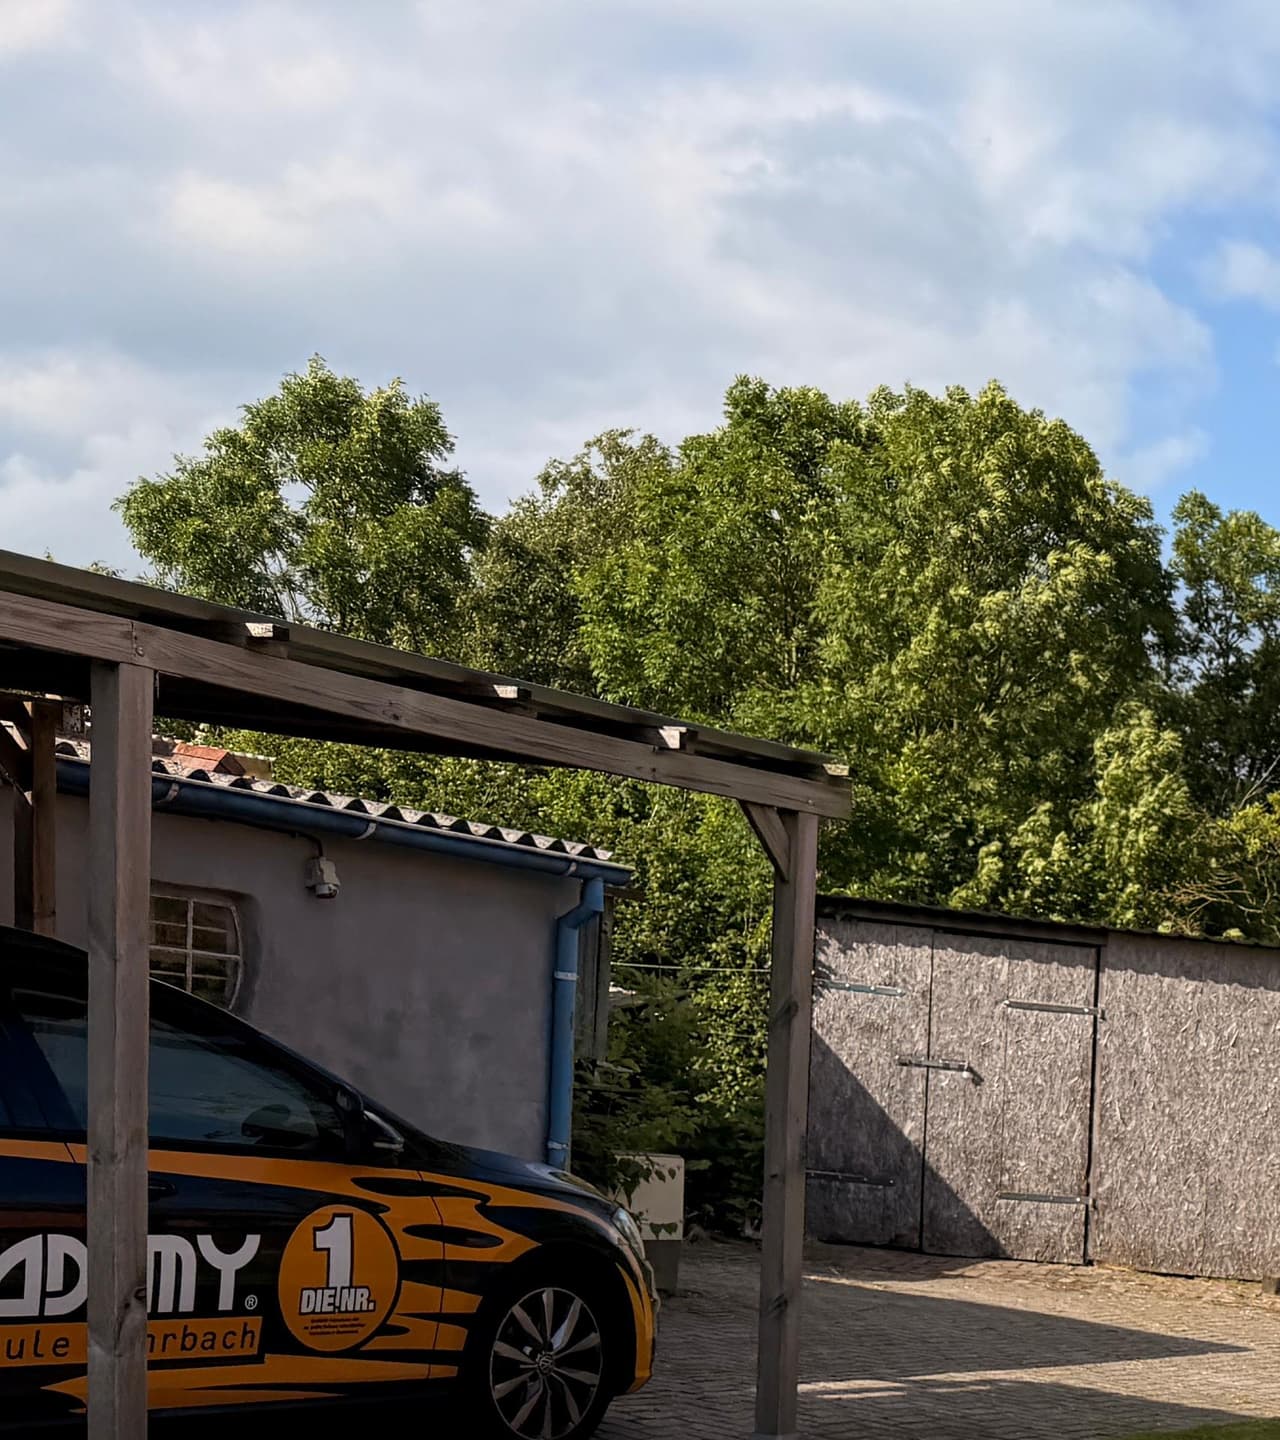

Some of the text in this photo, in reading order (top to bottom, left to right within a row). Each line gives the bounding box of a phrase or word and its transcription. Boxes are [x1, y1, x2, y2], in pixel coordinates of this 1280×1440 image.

[313, 1214, 353, 1288] 1
[300, 1287, 375, 1314] DIE NR.
